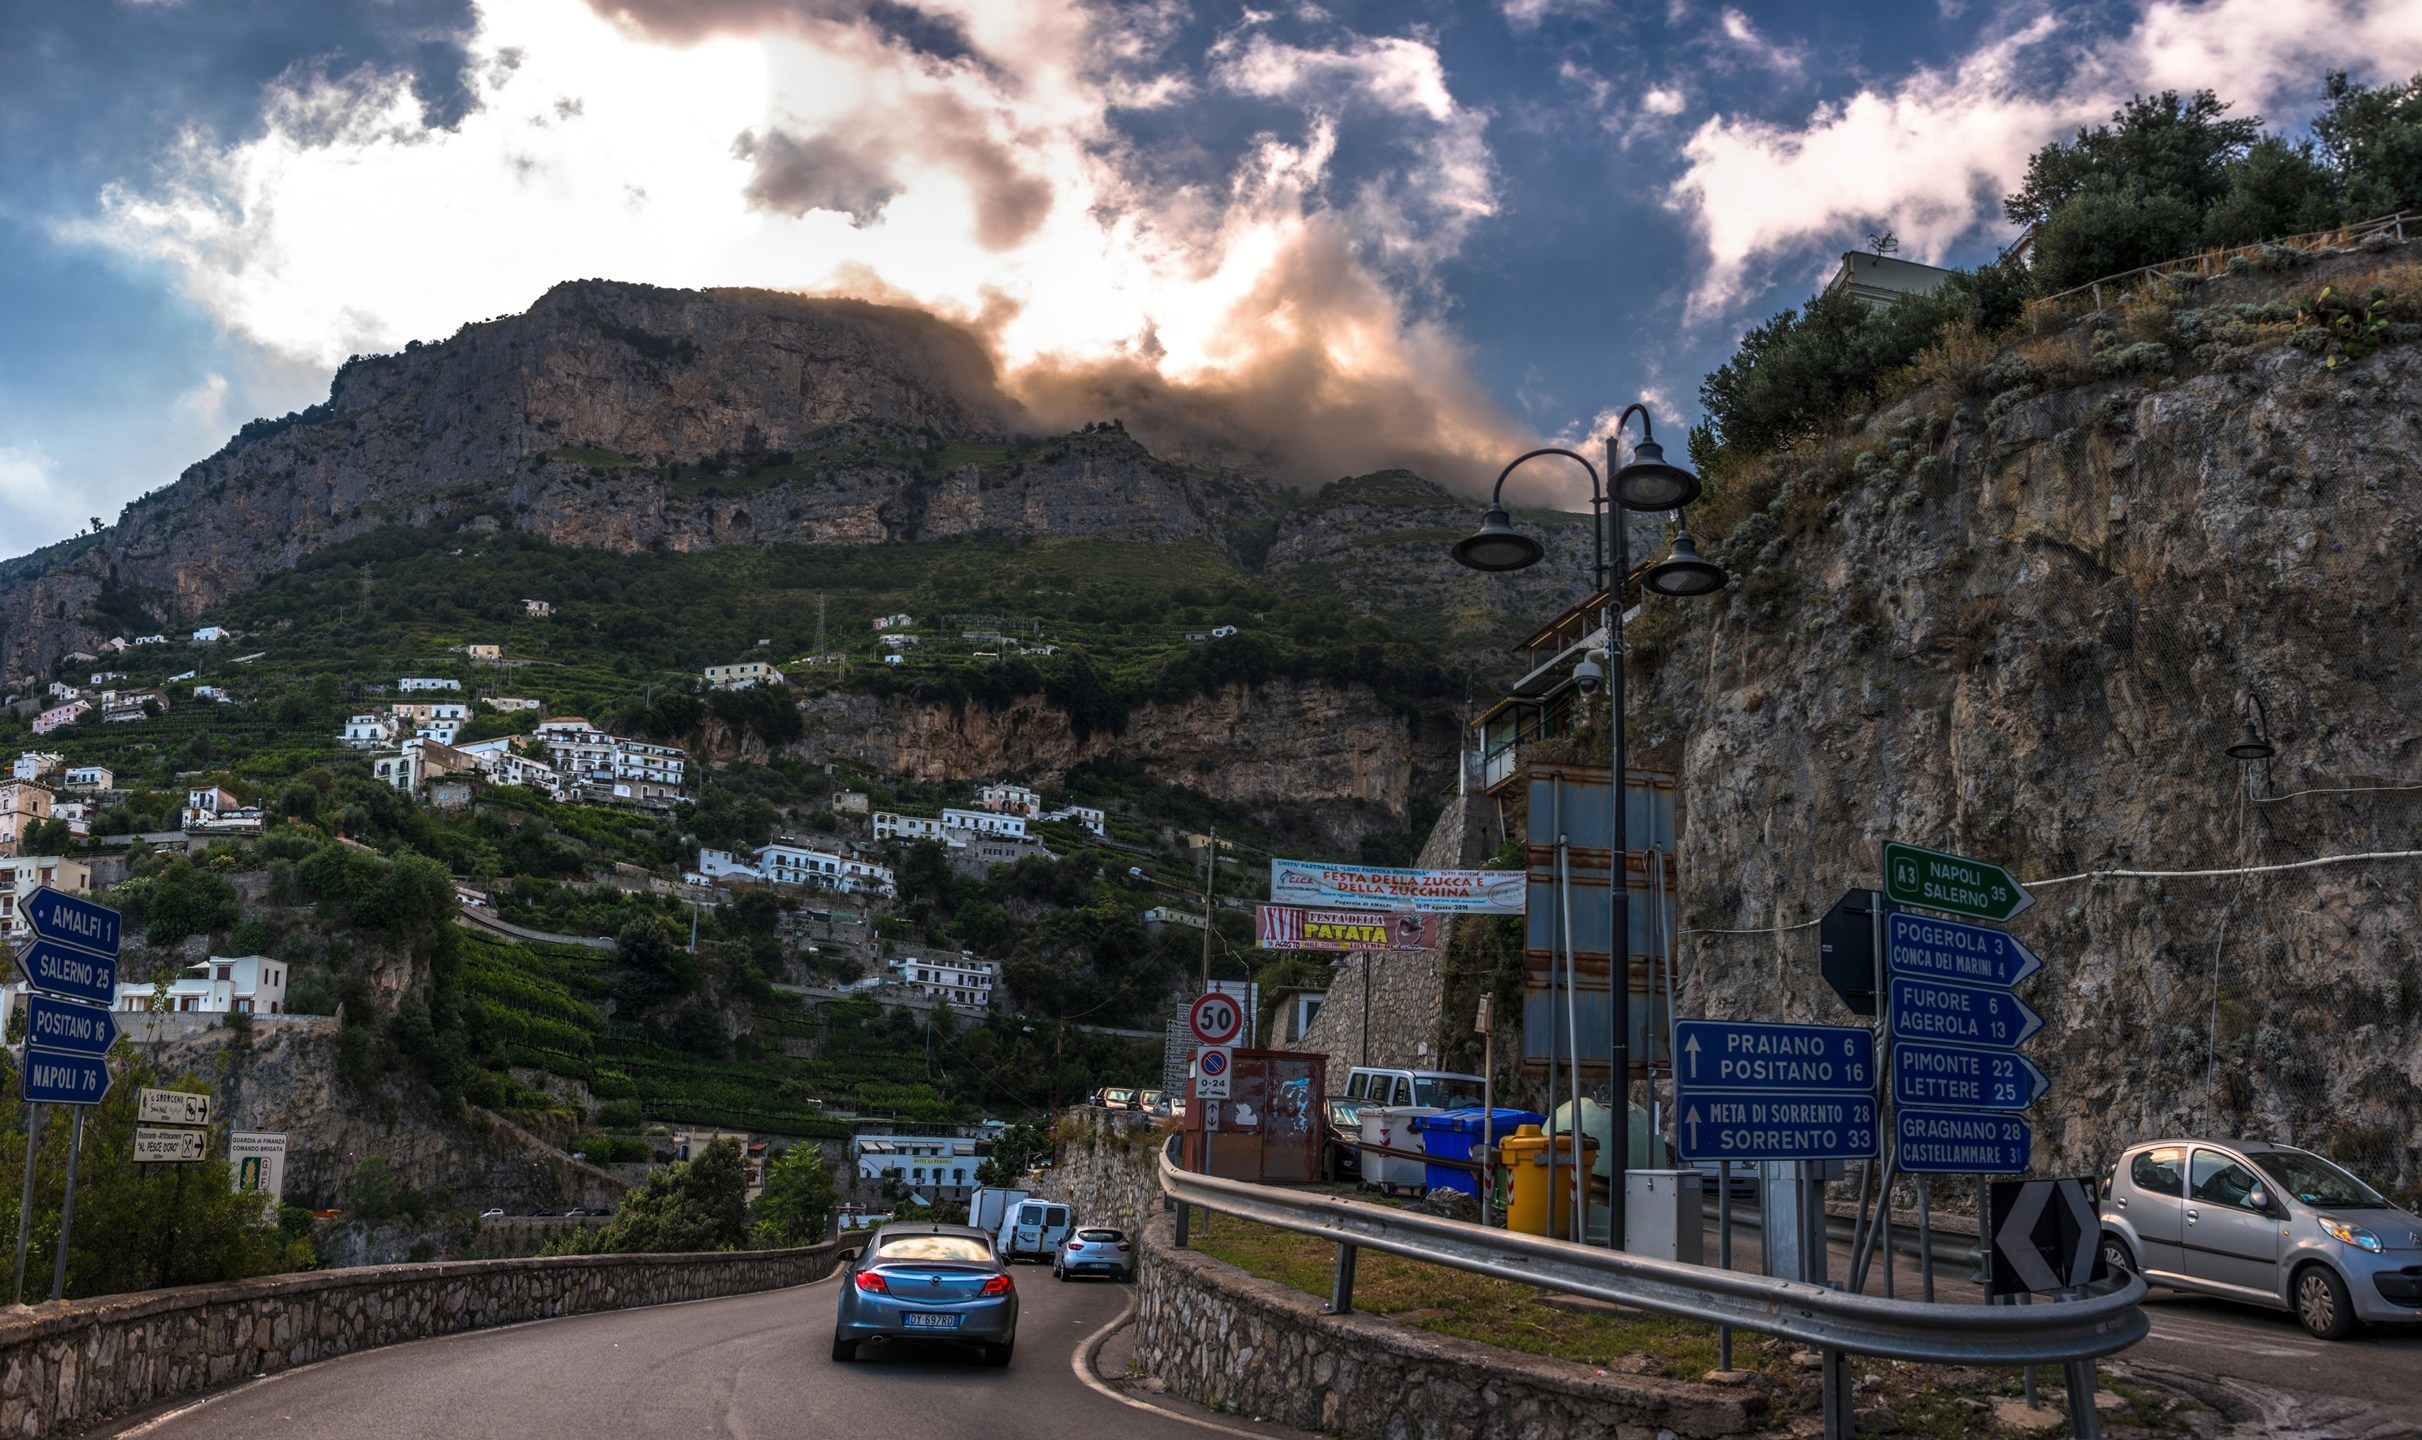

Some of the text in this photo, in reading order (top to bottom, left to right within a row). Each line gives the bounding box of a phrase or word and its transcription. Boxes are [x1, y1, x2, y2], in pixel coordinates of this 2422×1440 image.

[1301, 863, 1338, 871] PASTORALE
[1898, 865, 1916, 885] A3
[1930, 862, 1981, 886] NAPOLI
[1323, 871, 1485, 887] FESTA DELLA ZUCCA E
[1338, 882, 1470, 898] DELLA ZUCCHINA
[1924, 883, 1989, 908] SALERNO
[1991, 886, 2007, 902] 35
[52, 905, 112, 942] AMALFI 1
[1310, 913, 1383, 925] FESTA DELLA
[1305, 923, 1388, 943] PATATA
[1897, 922, 2003, 955] POGEROLA 3
[1275, 941, 1300, 949] AGOSTO
[40, 954, 109, 990] SALERNO 25
[1894, 946, 2005, 979] CONCA DEI MARINI 4
[1904, 987, 1998, 1015] FURORE 6
[37, 1010, 105, 1042] POSITANO 16
[1200, 1006, 1231, 1031] 50
[1900, 1011, 2006, 1039] AGEROLA 13
[1728, 1034, 1854, 1057] PRAIANO 6
[1721, 1060, 1864, 1082] POSITANO 16
[1903, 1052, 2014, 1078] PIMONTE 22
[33, 1065, 97, 1092] NAPOLI 76
[1201, 1079, 1225, 1087] 0-24
[1905, 1077, 2016, 1101] LETTERE 25
[1710, 1103, 1870, 1124] META DI SORRENTO 28
[1720, 1130, 1871, 1150] SORRENTO 33
[1903, 1118, 2021, 1141] GRAGNANO 28
[147, 1142, 162, 1152] PESCE
[1903, 1144, 2000, 1164] CASTELLAMMARE
[910, 1314, 922, 1325] DY
